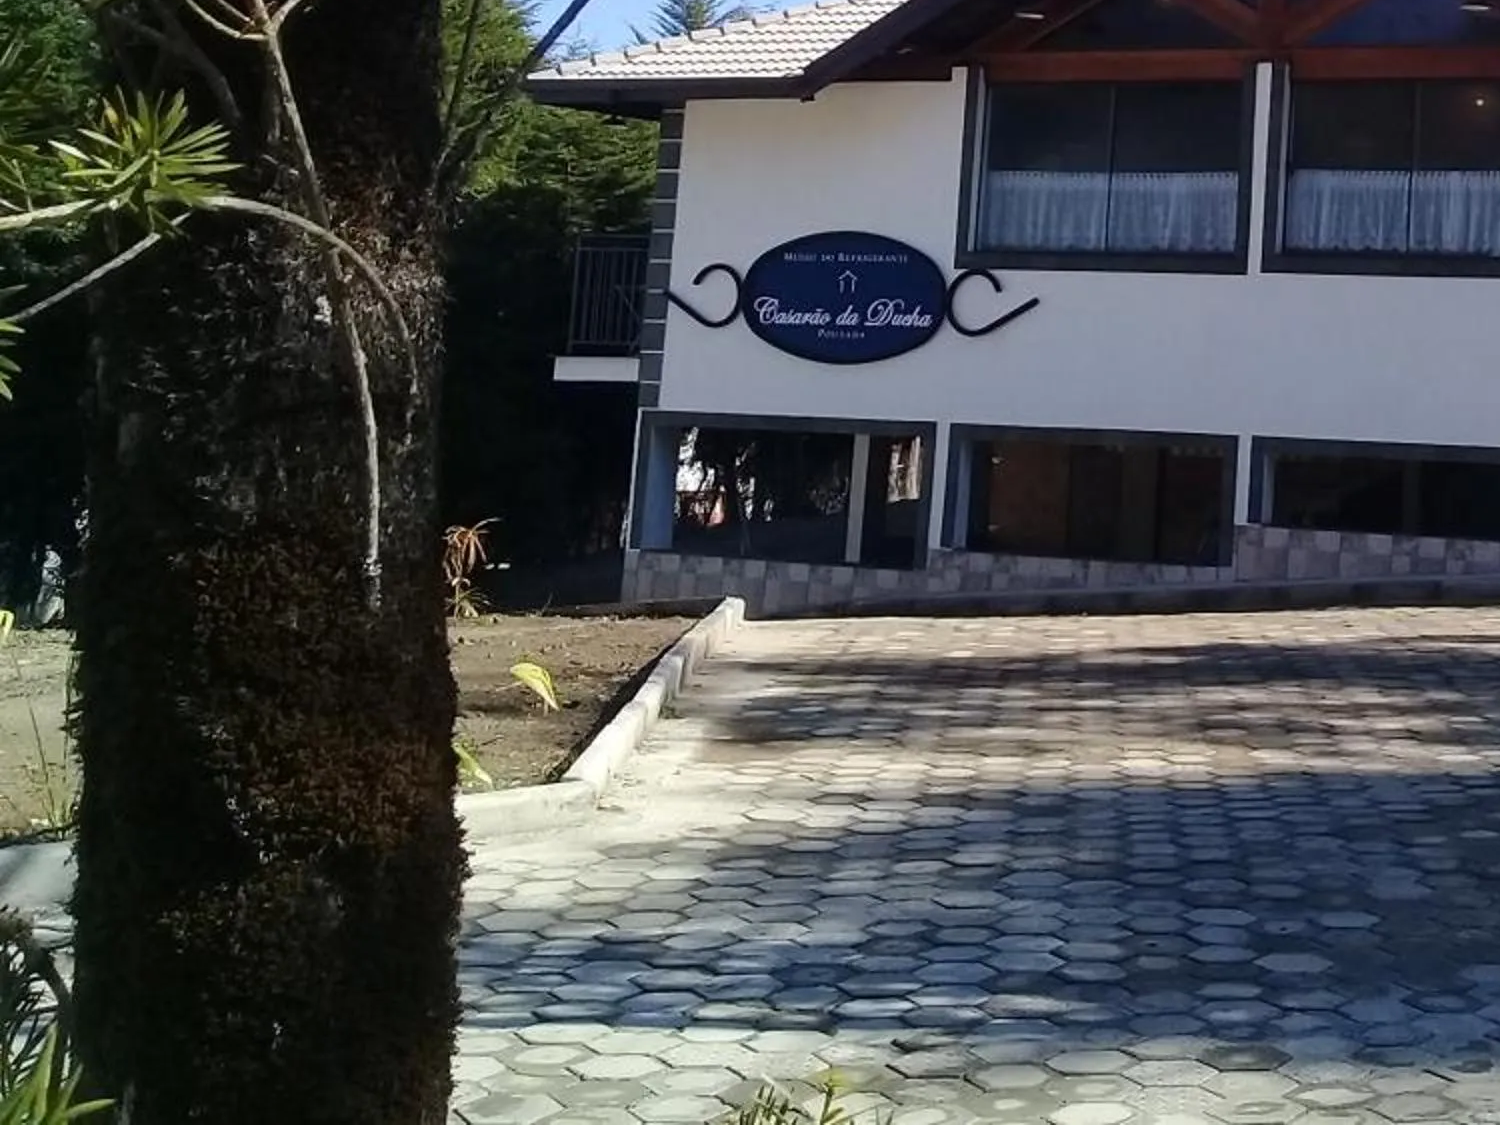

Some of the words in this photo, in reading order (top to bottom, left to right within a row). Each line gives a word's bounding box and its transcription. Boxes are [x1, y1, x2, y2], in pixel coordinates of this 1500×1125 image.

[753, 295, 832, 326] Casarão
[835, 304, 860, 326] da
[864, 298, 933, 327] Ducha
